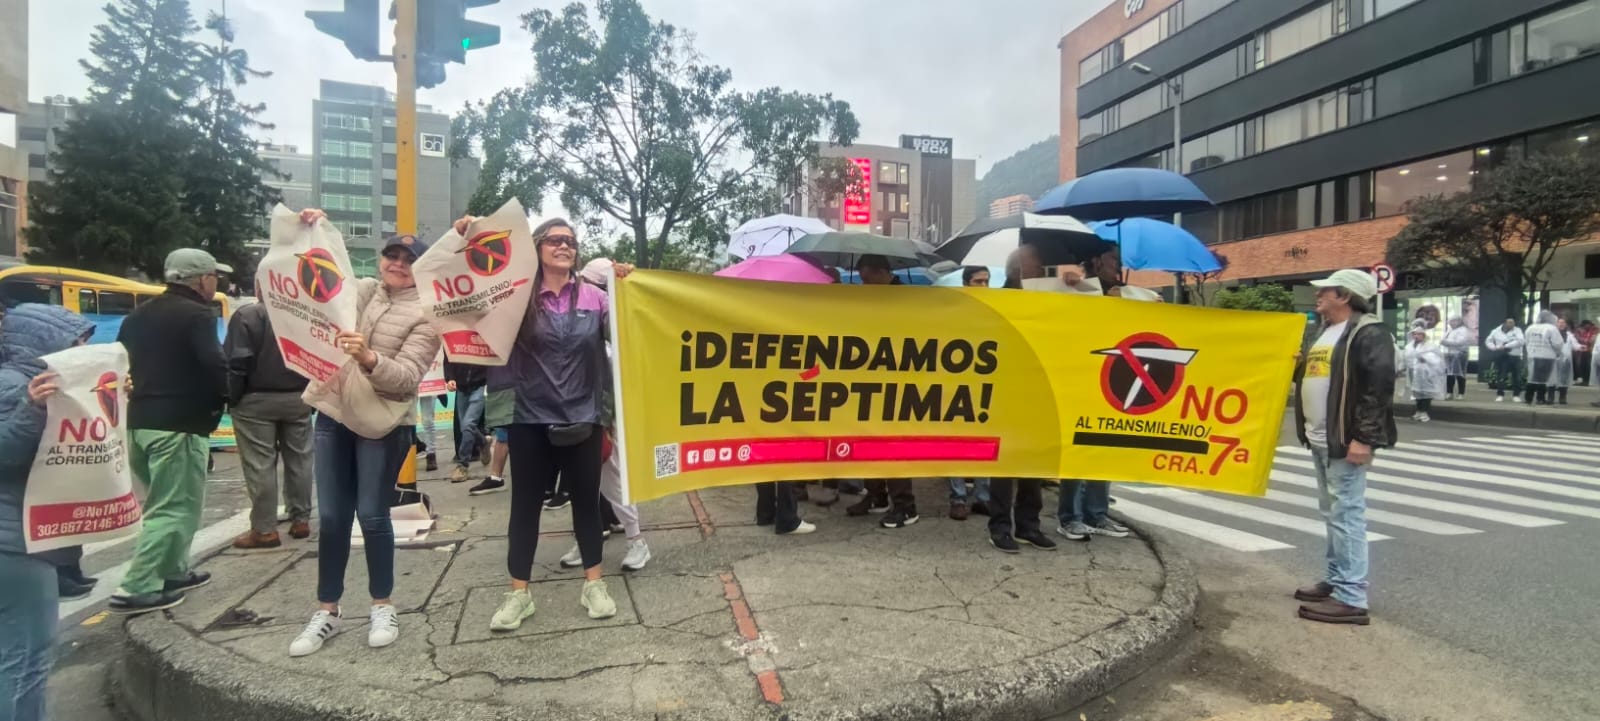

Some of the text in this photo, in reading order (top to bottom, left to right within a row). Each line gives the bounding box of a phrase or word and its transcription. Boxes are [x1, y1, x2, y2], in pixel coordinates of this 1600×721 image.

[913, 138, 948, 147] BODY
[914, 145, 949, 154] TECH
[268, 269, 299, 300] NO
[433, 274, 474, 302] NO
[433, 304, 445, 312] AL
[679, 330, 998, 375] ¡DEFENDAMOS
[680, 364, 994, 426] LA SÉPTIMA!
[1180, 385, 1249, 425] NO
[58, 416, 107, 443] NO
[1075, 416, 1213, 439] AL TRANSMILENIO/
[47, 445, 63, 455] AL
[1152, 453, 1205, 475] CRA.
[37, 523, 58, 537] 302
